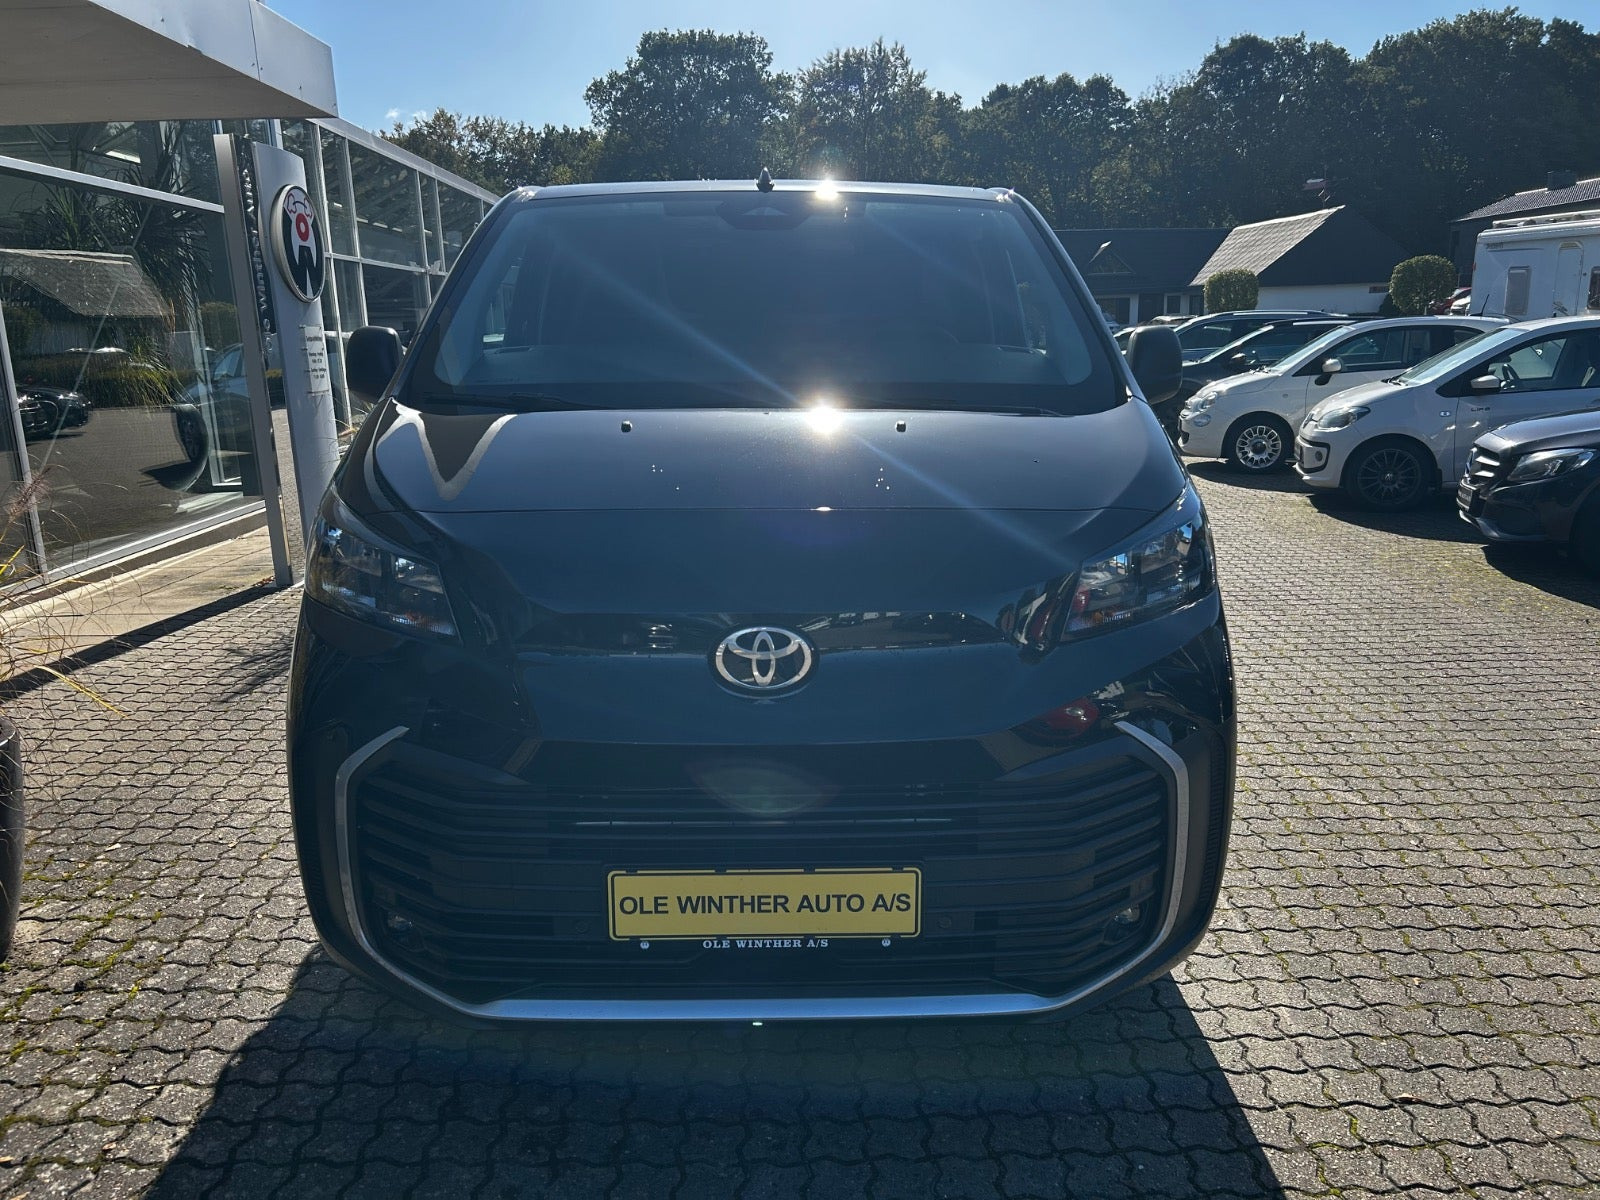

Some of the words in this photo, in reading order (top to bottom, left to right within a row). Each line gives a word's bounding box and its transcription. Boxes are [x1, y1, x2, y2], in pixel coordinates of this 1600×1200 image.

[619, 896, 669, 915] OLE
[676, 894, 790, 914] WINTHER
[796, 893, 865, 913] AUTO
[871, 893, 911, 912] A/S
[702, 939, 731, 949] OLE
[735, 938, 802, 949] WINTHER
[806, 938, 829, 948] A/S
